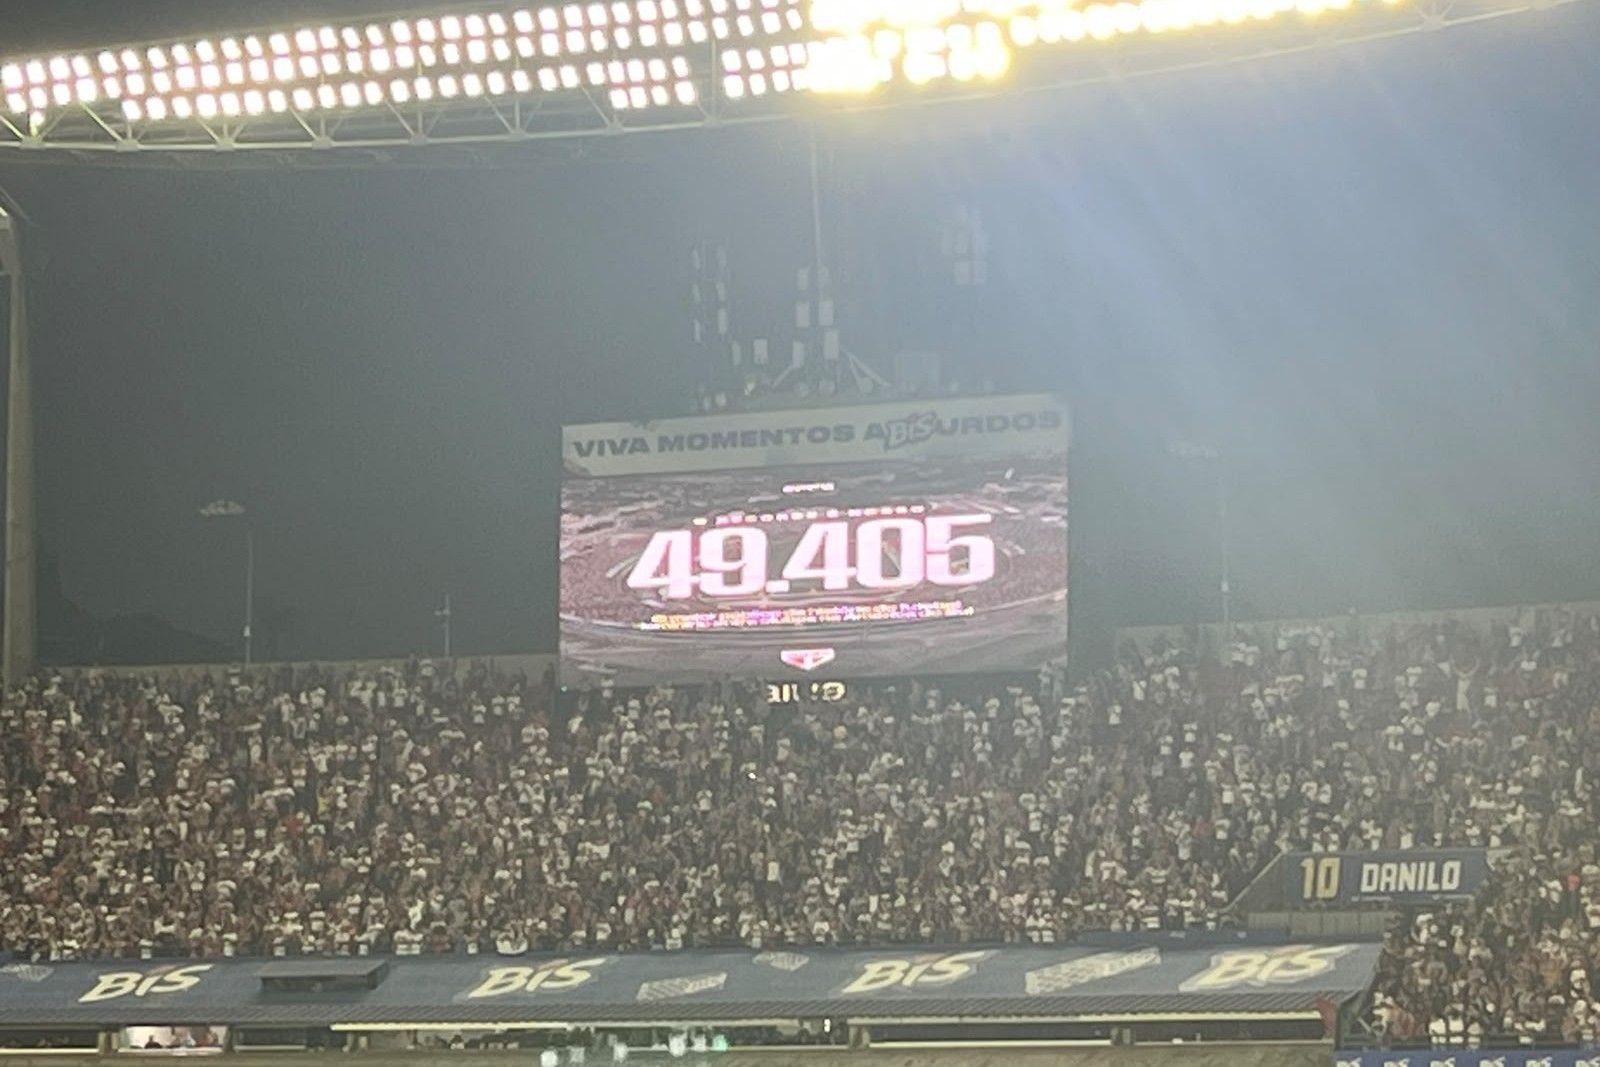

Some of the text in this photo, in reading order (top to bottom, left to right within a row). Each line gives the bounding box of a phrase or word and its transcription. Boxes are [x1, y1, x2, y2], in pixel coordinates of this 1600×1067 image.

[573, 437, 651, 458] VIVA
[657, 424, 855, 454] MOMENTOS
[626, 513, 996, 599] 49.405
[1301, 857, 1462, 899] 10 DANILO
